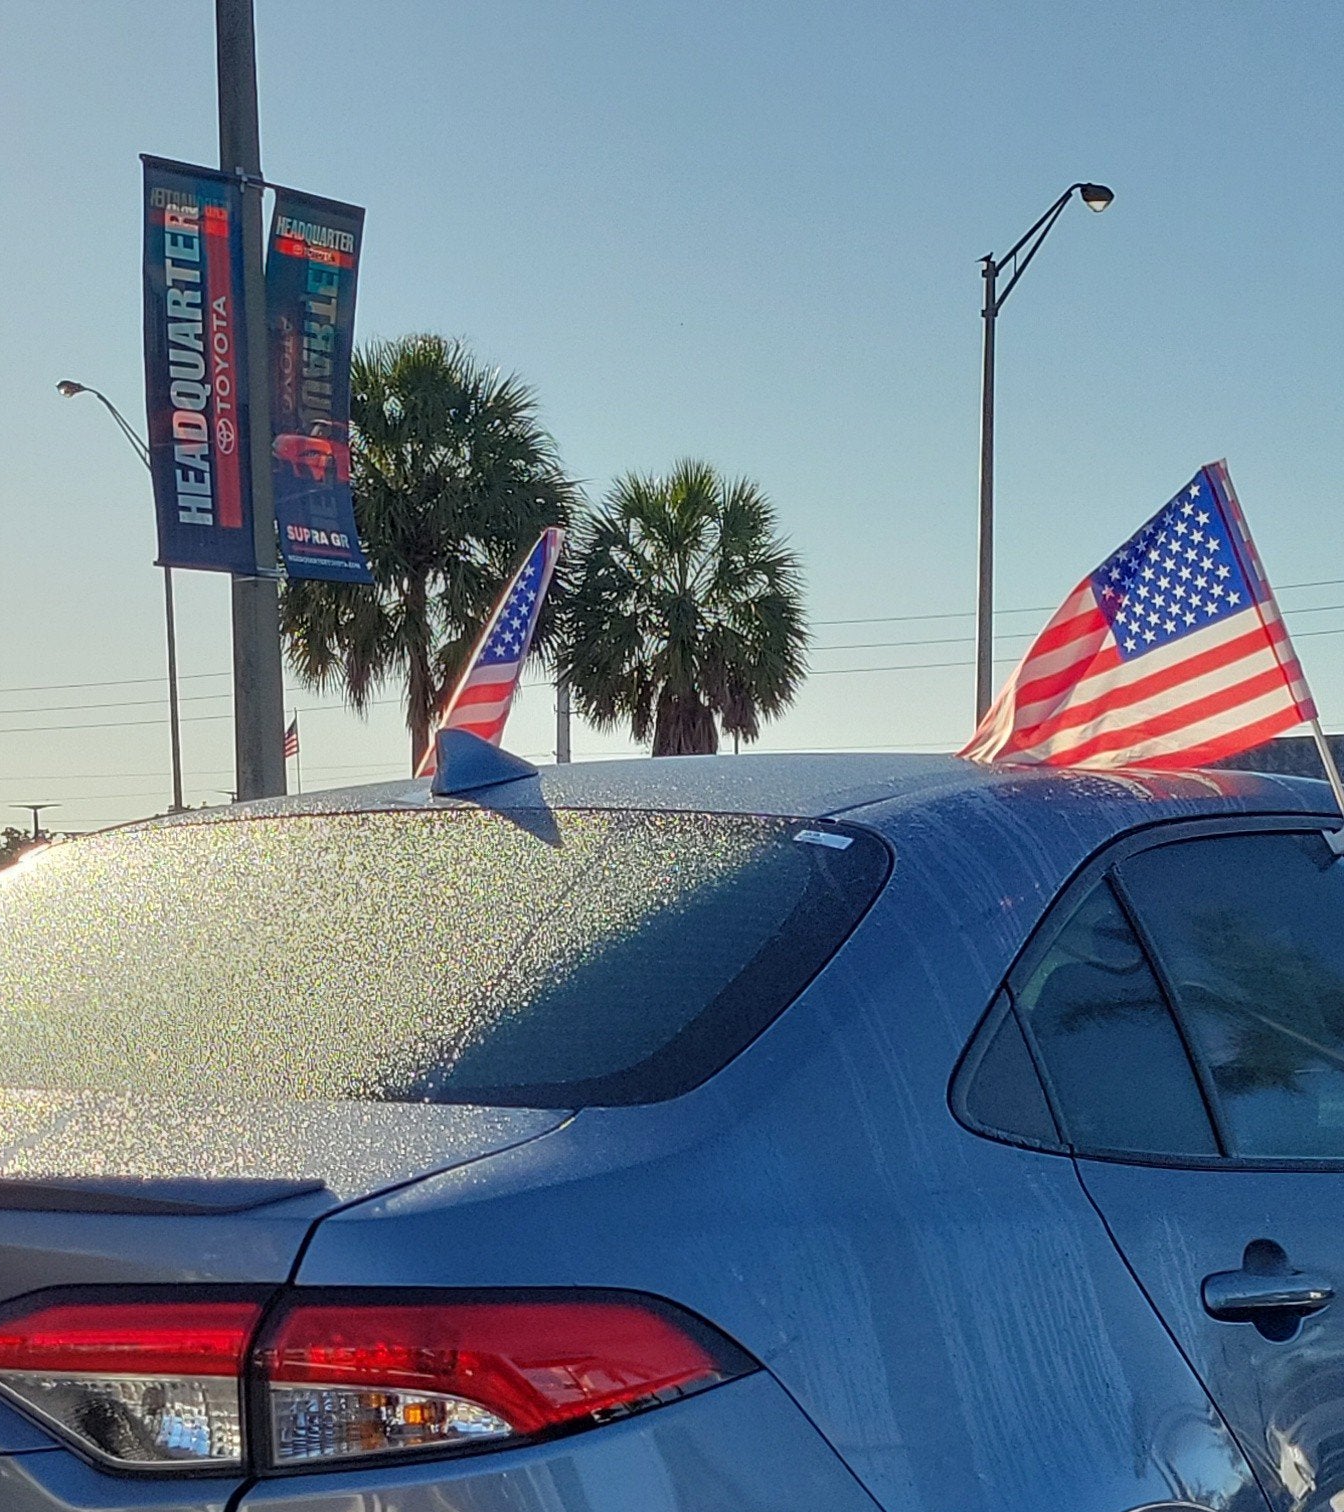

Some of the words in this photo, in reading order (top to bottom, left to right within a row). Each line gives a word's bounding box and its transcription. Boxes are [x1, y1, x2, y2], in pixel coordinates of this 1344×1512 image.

[276, 215, 355, 253] HEADQUARTER
[164, 203, 214, 527] HEADQUARTER
[211, 296, 232, 414] TOYOTA
[287, 524, 329, 546] SUPRA
[330, 532, 350, 549] GR
